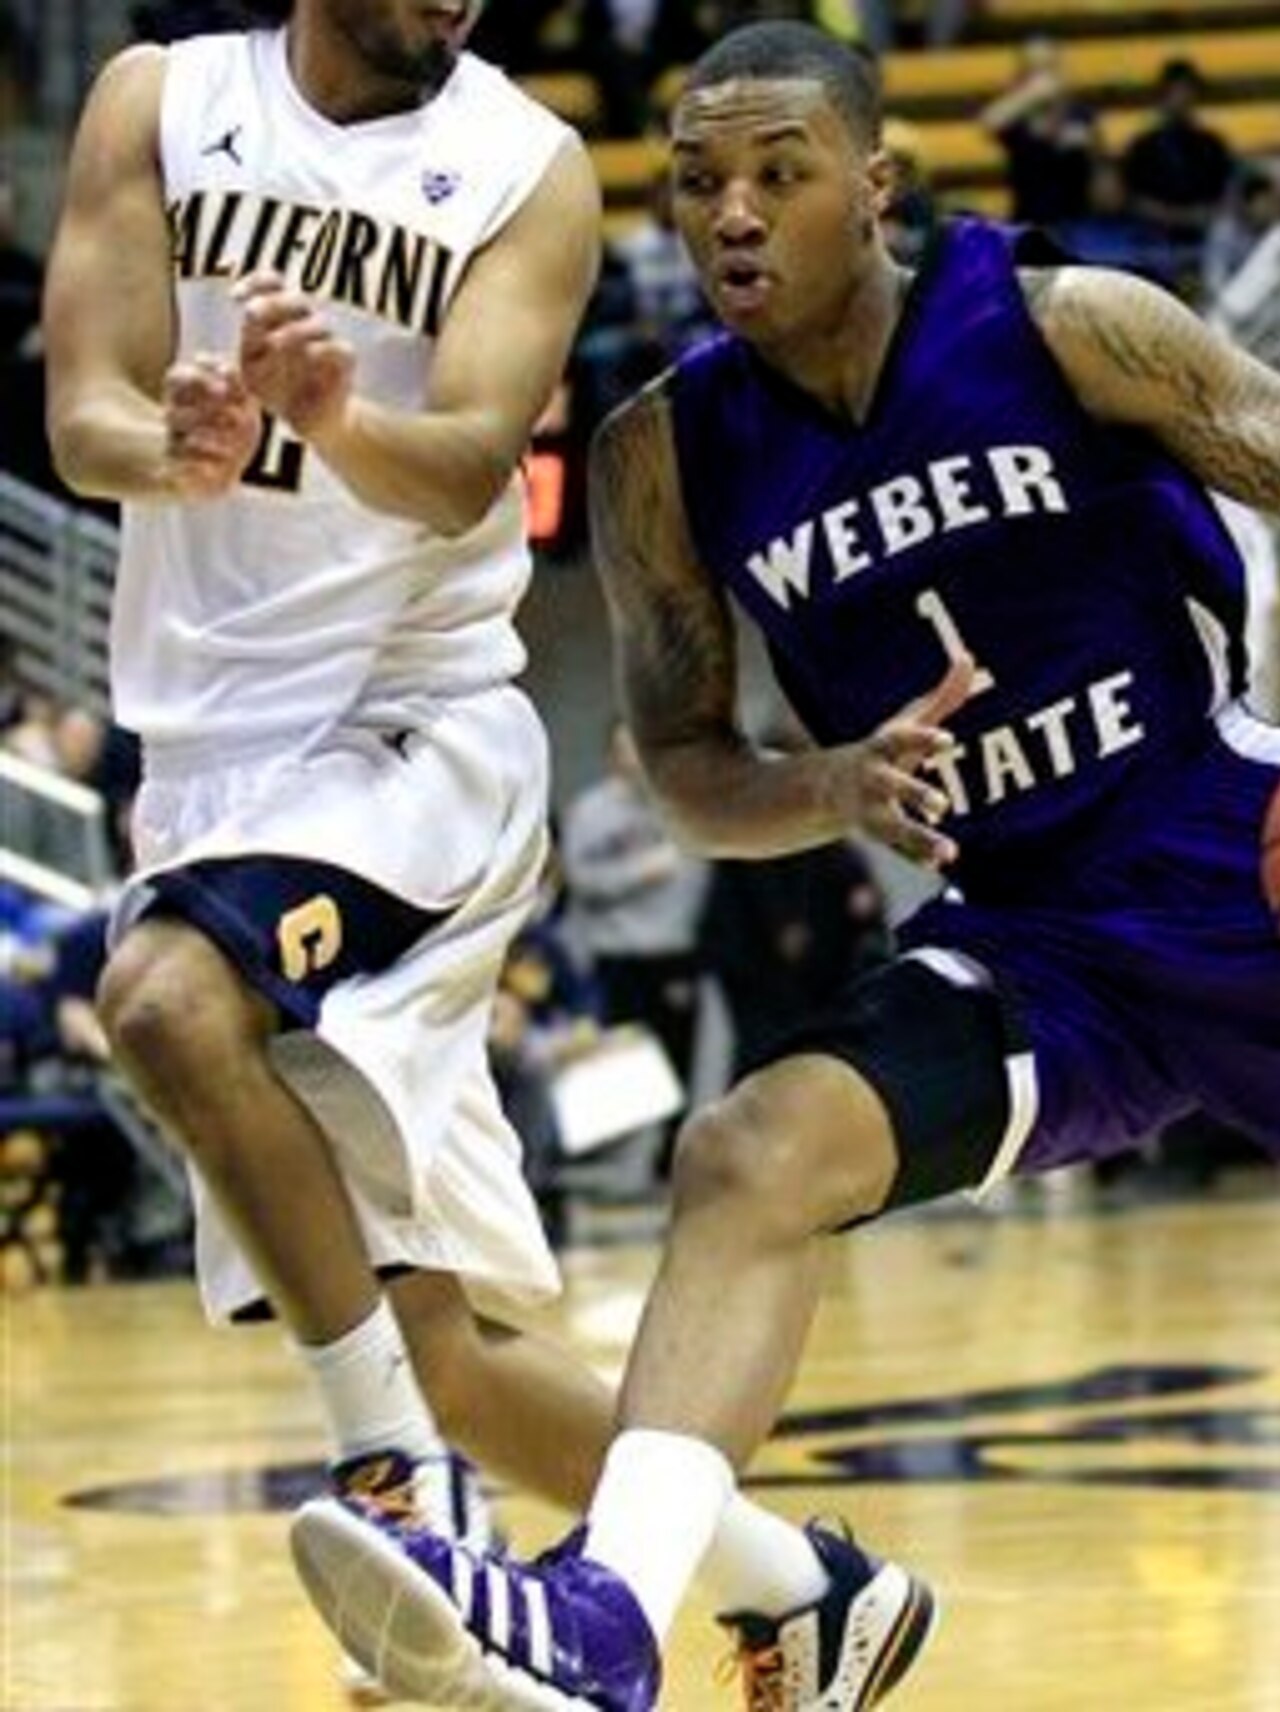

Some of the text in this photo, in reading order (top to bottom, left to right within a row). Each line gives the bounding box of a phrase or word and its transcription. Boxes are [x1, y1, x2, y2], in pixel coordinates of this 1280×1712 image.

[168, 191, 452, 338] ALIFORNI
[746, 444, 1069, 610] WEBER
[916, 588, 995, 694] 1
[922, 669, 1146, 818] TATE
[276, 893, 342, 982] C
